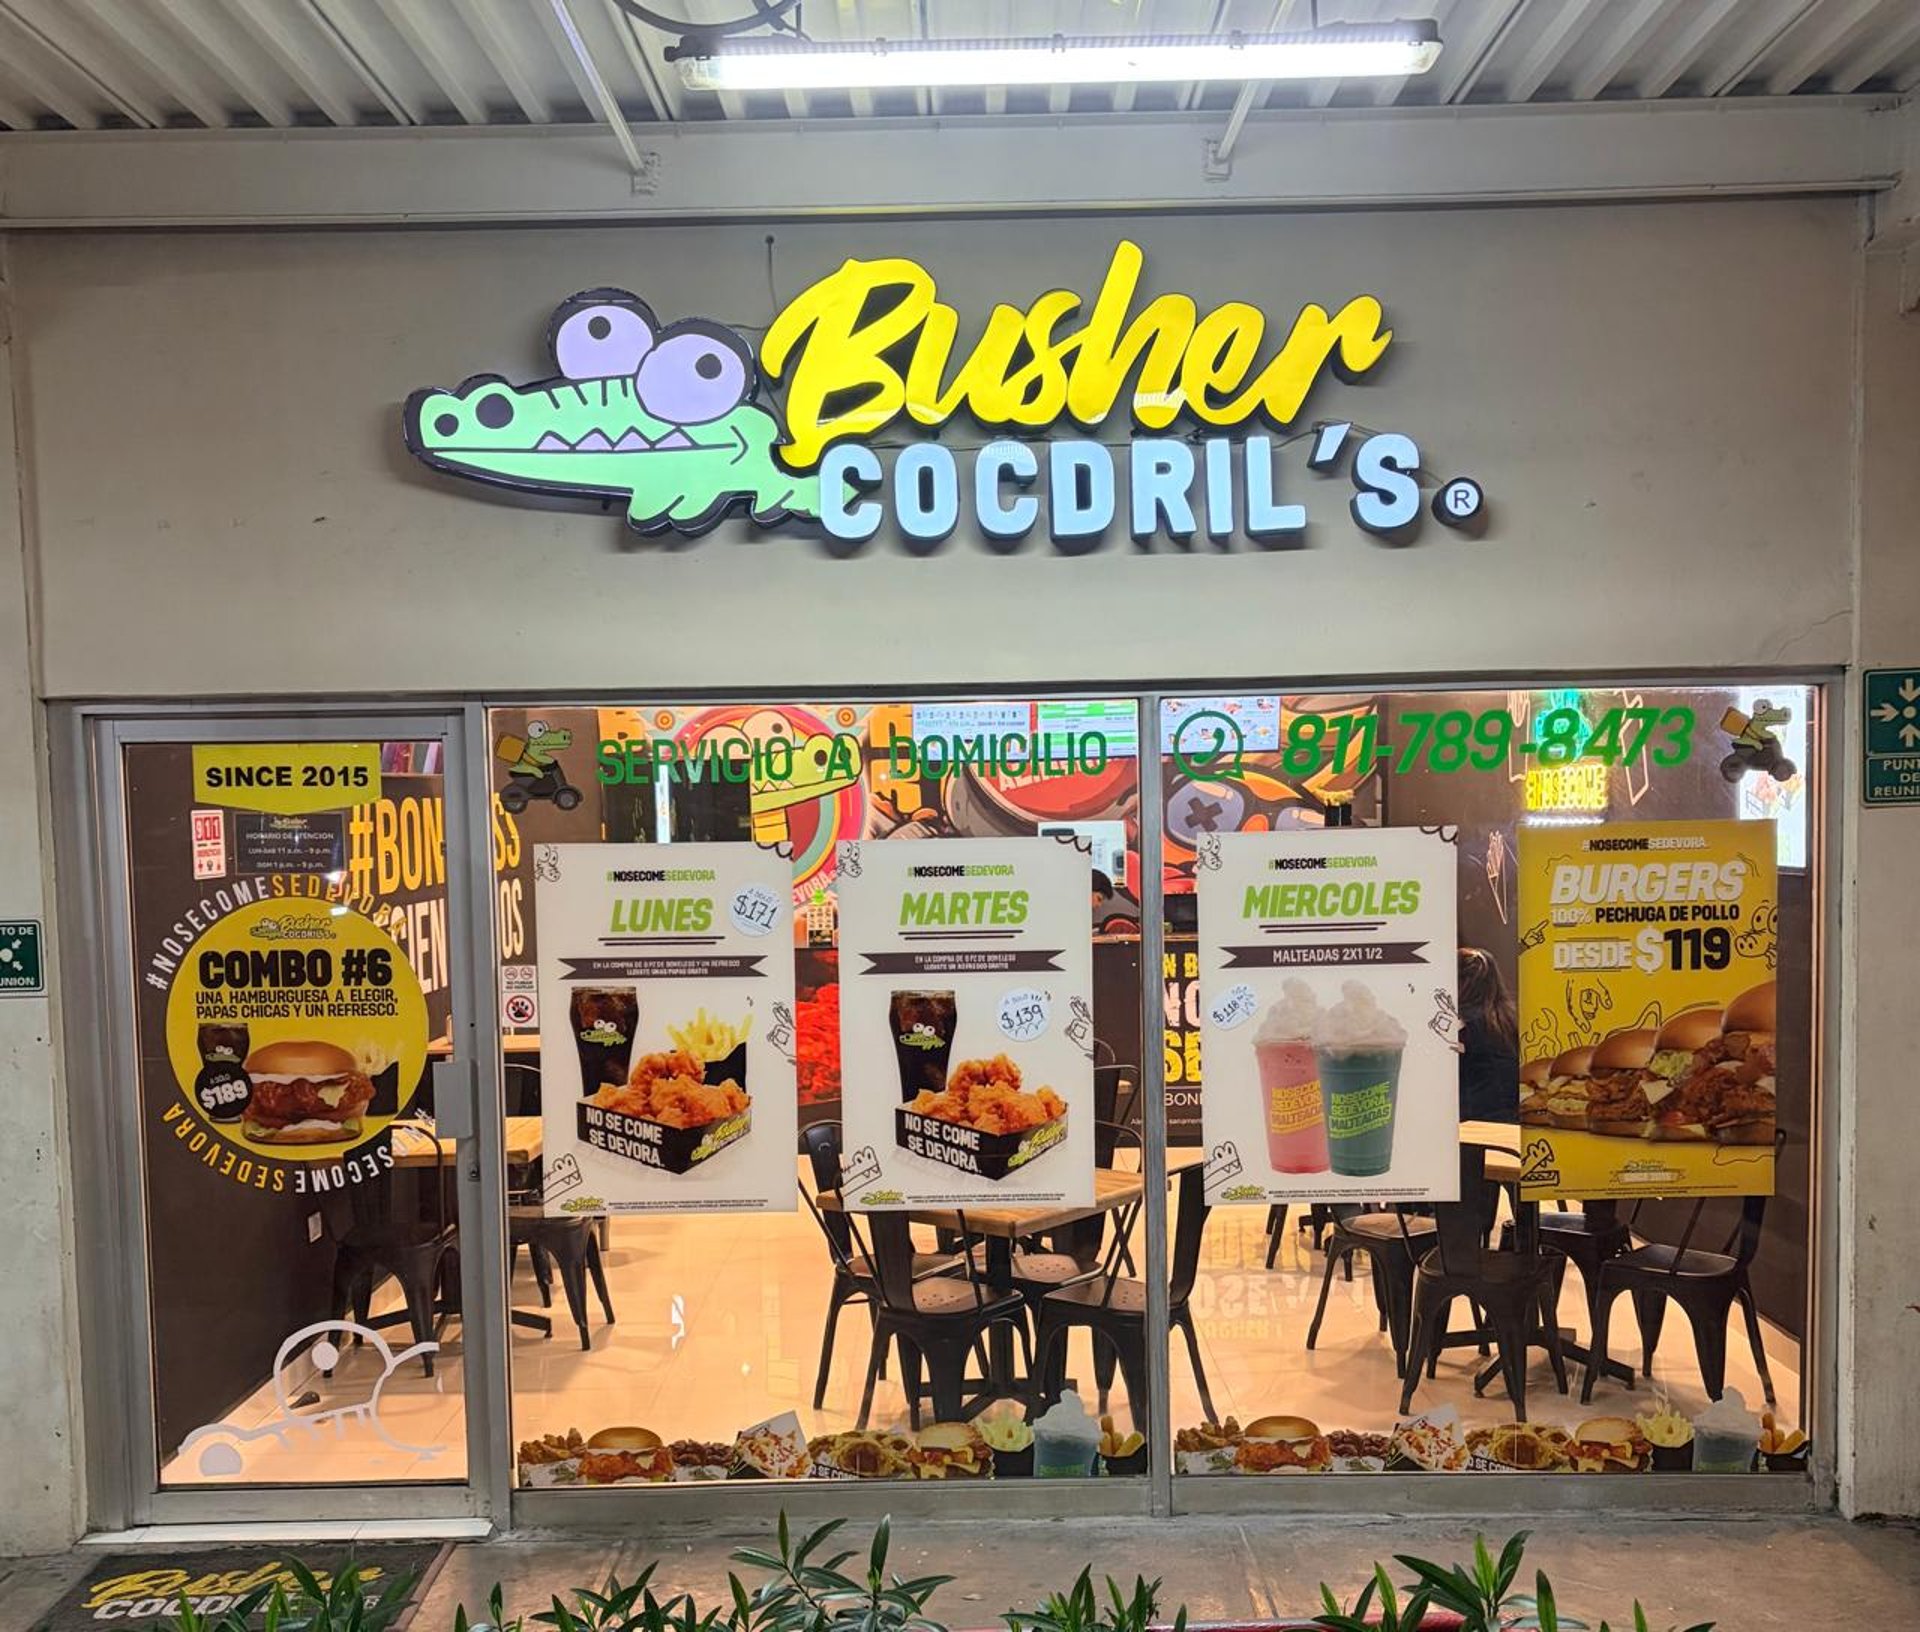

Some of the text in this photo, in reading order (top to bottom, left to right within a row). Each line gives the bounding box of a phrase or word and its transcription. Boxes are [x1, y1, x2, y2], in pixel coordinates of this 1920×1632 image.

[760, 238, 1394, 471] Busher
[594, 735, 794, 786] SERVICIO
[824, 732, 855, 781] A
[888, 730, 1108, 780] DOMICILIO
[1883, 759, 1920, 771] PUNT
[206, 765, 370, 788] SINCE 2015
[1874, 785, 1920, 797] REUNI
[195, 816, 221, 841] 911
[606, 869, 717, 883] #NOSECOMESEDEVORA
[906, 863, 1016, 878] #NOSECOMESEDEVORA
[1267, 855, 1379, 871] #NOSECOMESEDEVORA
[1550, 859, 1748, 905] BURGERS
[609, 897, 714, 933] LUNES
[733, 894, 778, 930] $171
[899, 889, 1030, 927] MARTES
[1242, 879, 1422, 920] MIERCOLES
[1550, 904, 1741, 925] 100% PECHUGA DE POLLO
[18, 926, 35, 936] DE
[1272, 946, 1383, 965] MALTEADAS 2X1 1/2
[1553, 926, 1732, 976] DESDE $119
[198, 948, 393, 990] COMBO #6
[195, 988, 399, 1005] UNA HAMBURGUESA A ELEGIR,
[196, 1003, 400, 1019] PAPAS CHICAS Y UN REFRESCO.
[1001, 1003, 1044, 1031] $139
[201, 1079, 249, 1110] $189
[585, 1106, 664, 1145] NO SE COME
[904, 1113, 981, 1150] NO SE COME
[589, 1129, 665, 1168] SE DEVORA.
[907, 1135, 983, 1174] SE DEVORA.
